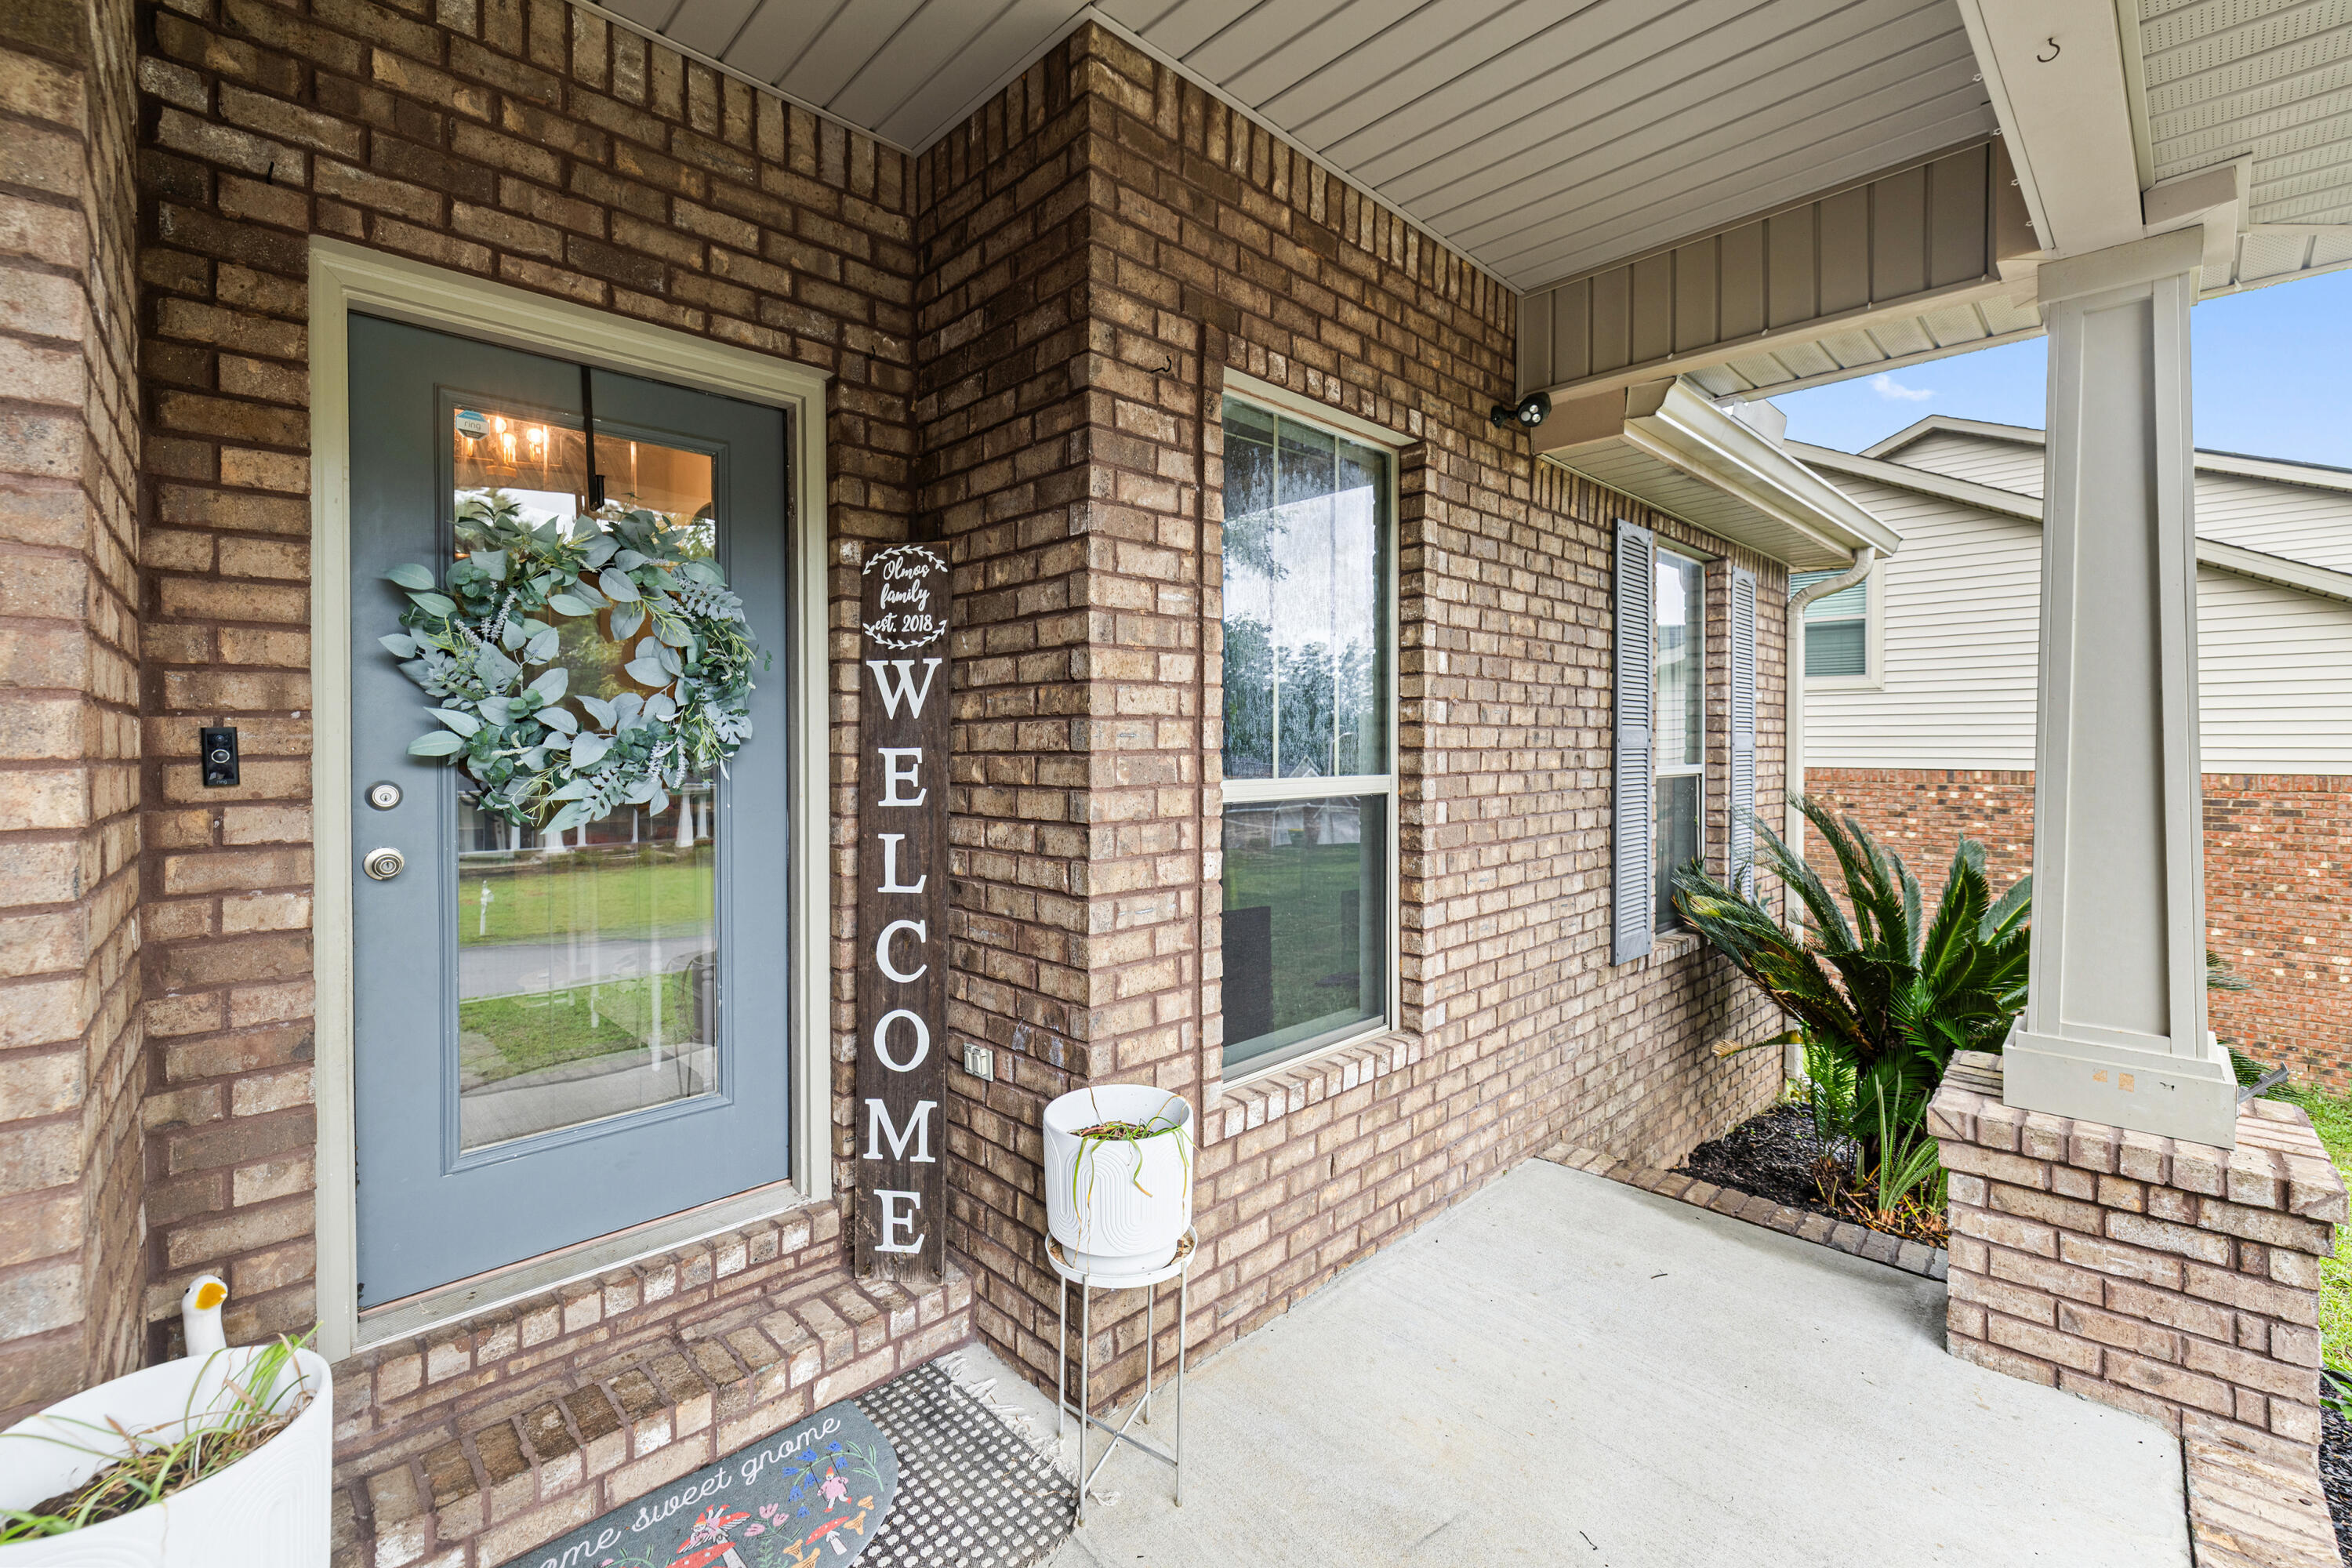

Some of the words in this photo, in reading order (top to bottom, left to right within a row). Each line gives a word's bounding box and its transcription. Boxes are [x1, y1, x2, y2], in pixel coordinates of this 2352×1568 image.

[464, 420, 481, 431] ring
[883, 556, 930, 580] Olmos
[880, 579, 930, 612] family
[875, 612, 898, 633] est.
[901, 614, 933, 632] 2018
[863, 658, 942, 1254] WELCOME
[632, 1466, 732, 1532] sweet
[741, 1417, 841, 1486] gnome
